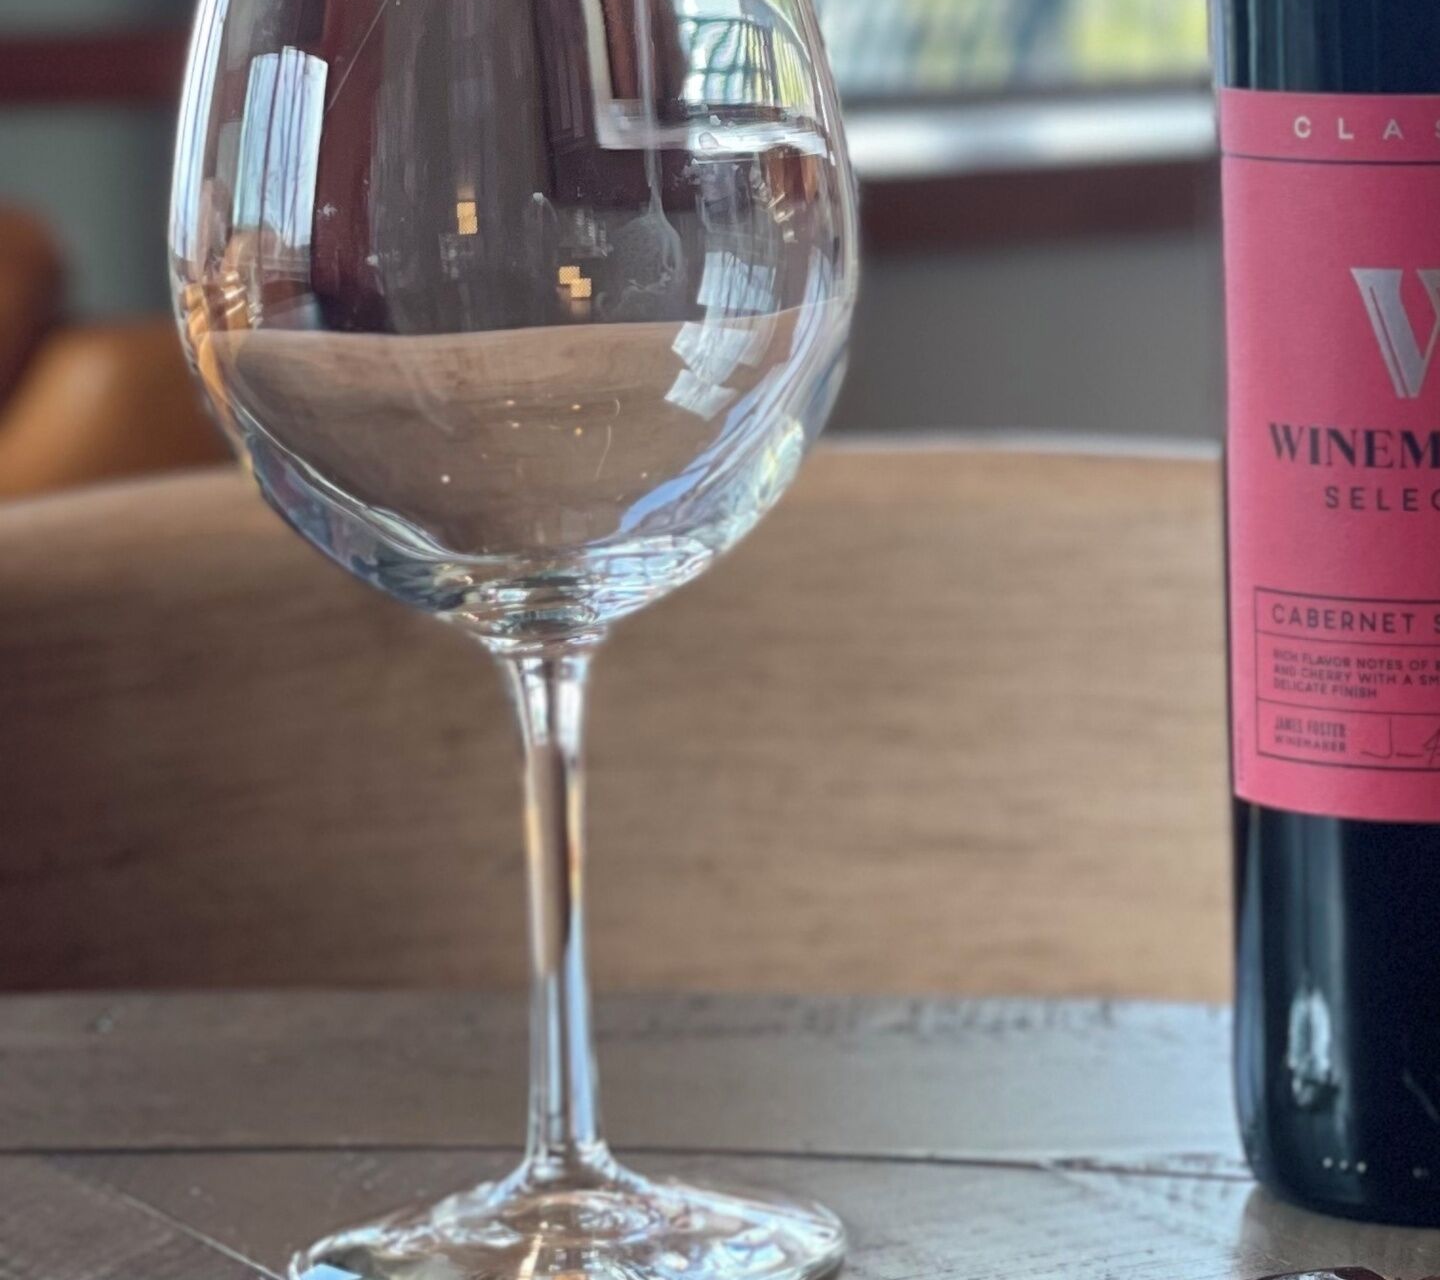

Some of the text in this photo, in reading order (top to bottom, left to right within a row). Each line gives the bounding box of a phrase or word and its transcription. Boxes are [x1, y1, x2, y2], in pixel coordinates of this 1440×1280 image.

[1272, 604, 1416, 634] CABERNET
[1303, 652, 1350, 668] FLAVOR
[1357, 657, 1402, 671] NOTES
[1409, 659, 1428, 671] OF
[1273, 663, 1296, 677] AND
[1301, 667, 1351, 682] CHERRY
[1358, 671, 1397, 685] WITH
[1403, 674, 1414, 686] A
[1273, 677, 1378, 699] DELICATE FINISH
